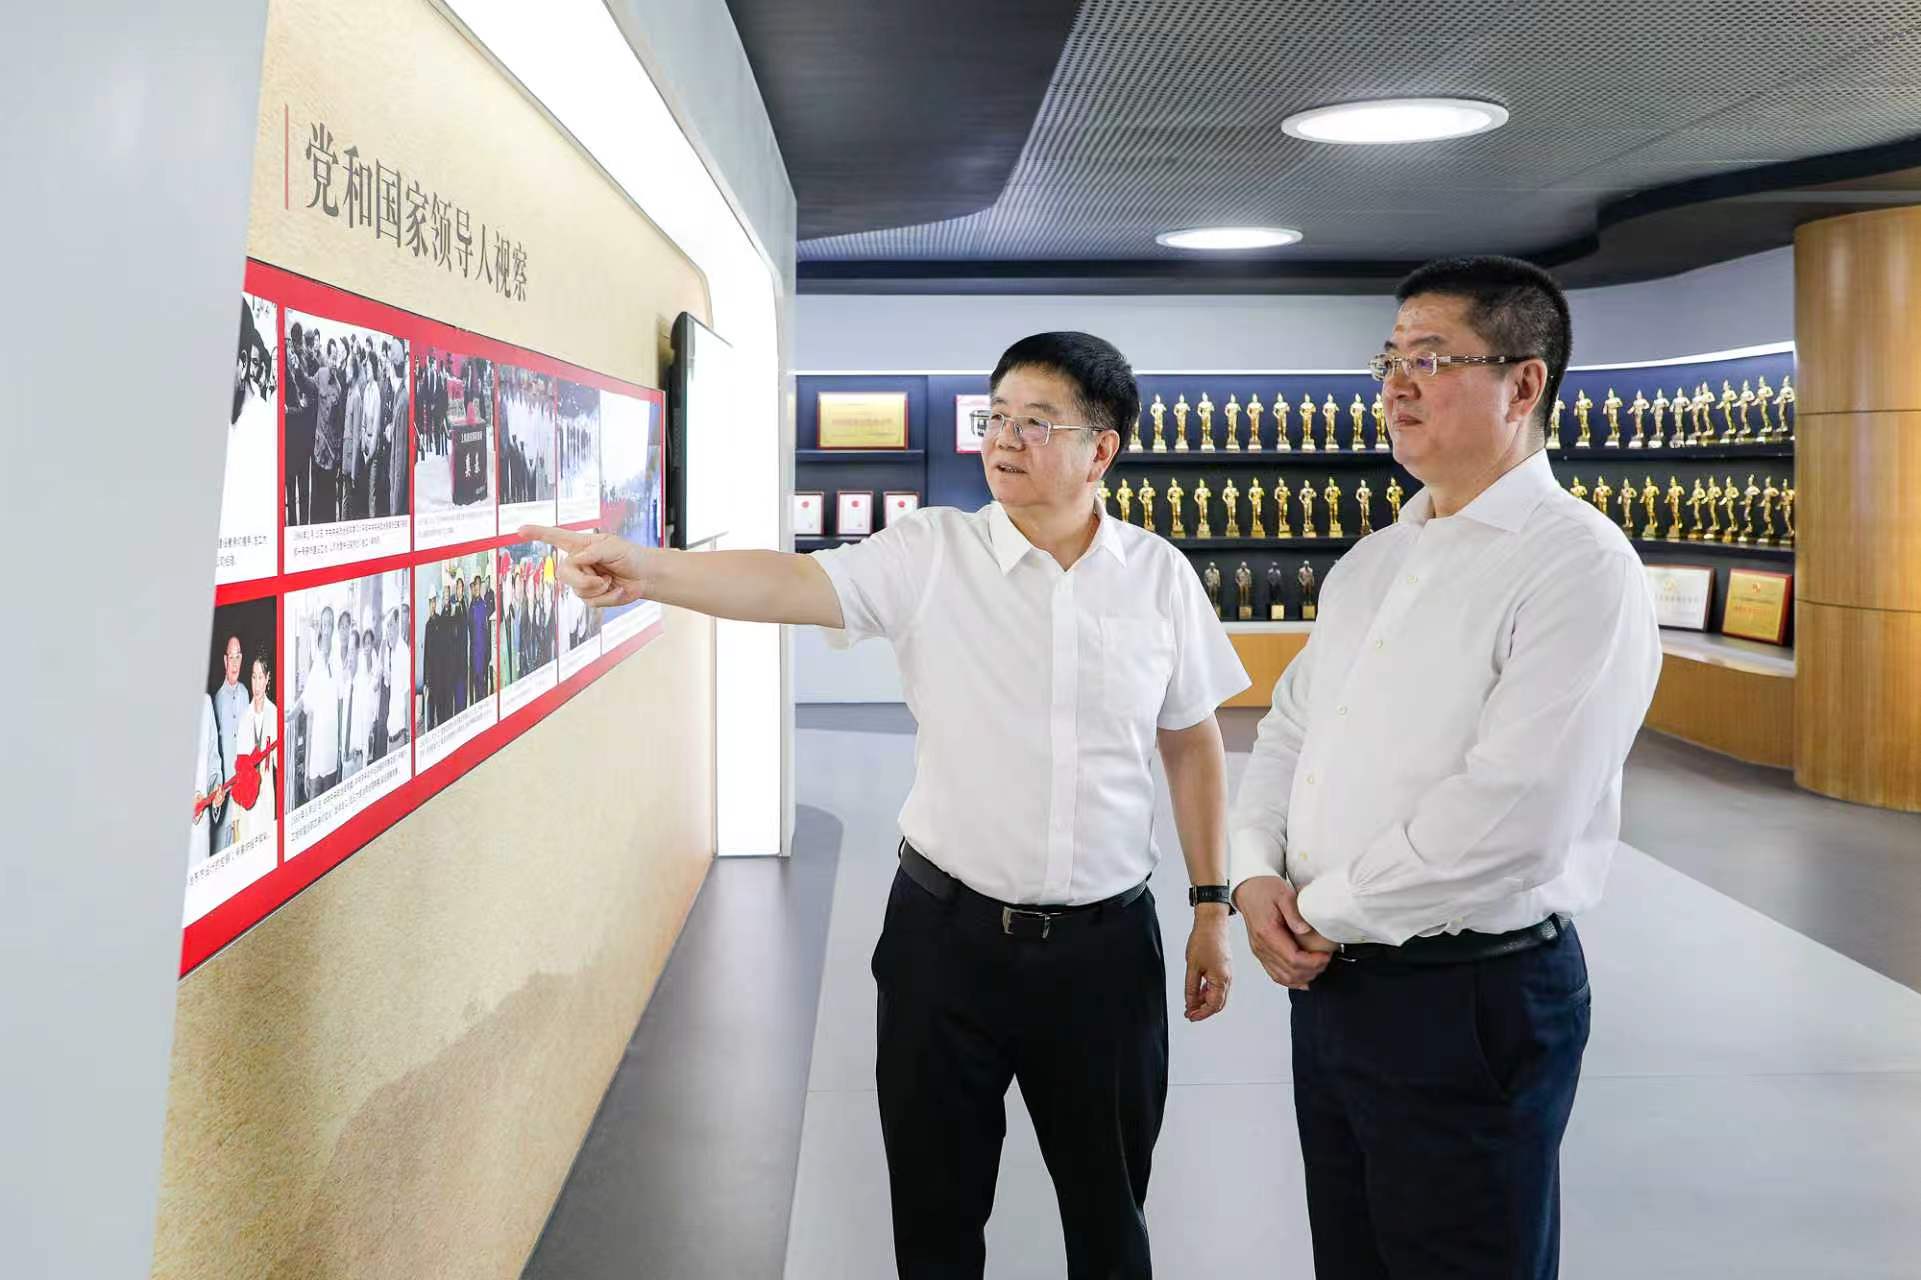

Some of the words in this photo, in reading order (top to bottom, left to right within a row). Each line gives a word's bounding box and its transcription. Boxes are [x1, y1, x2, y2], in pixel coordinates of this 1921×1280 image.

[305, 122, 528, 302] 党和国家领导人视察
